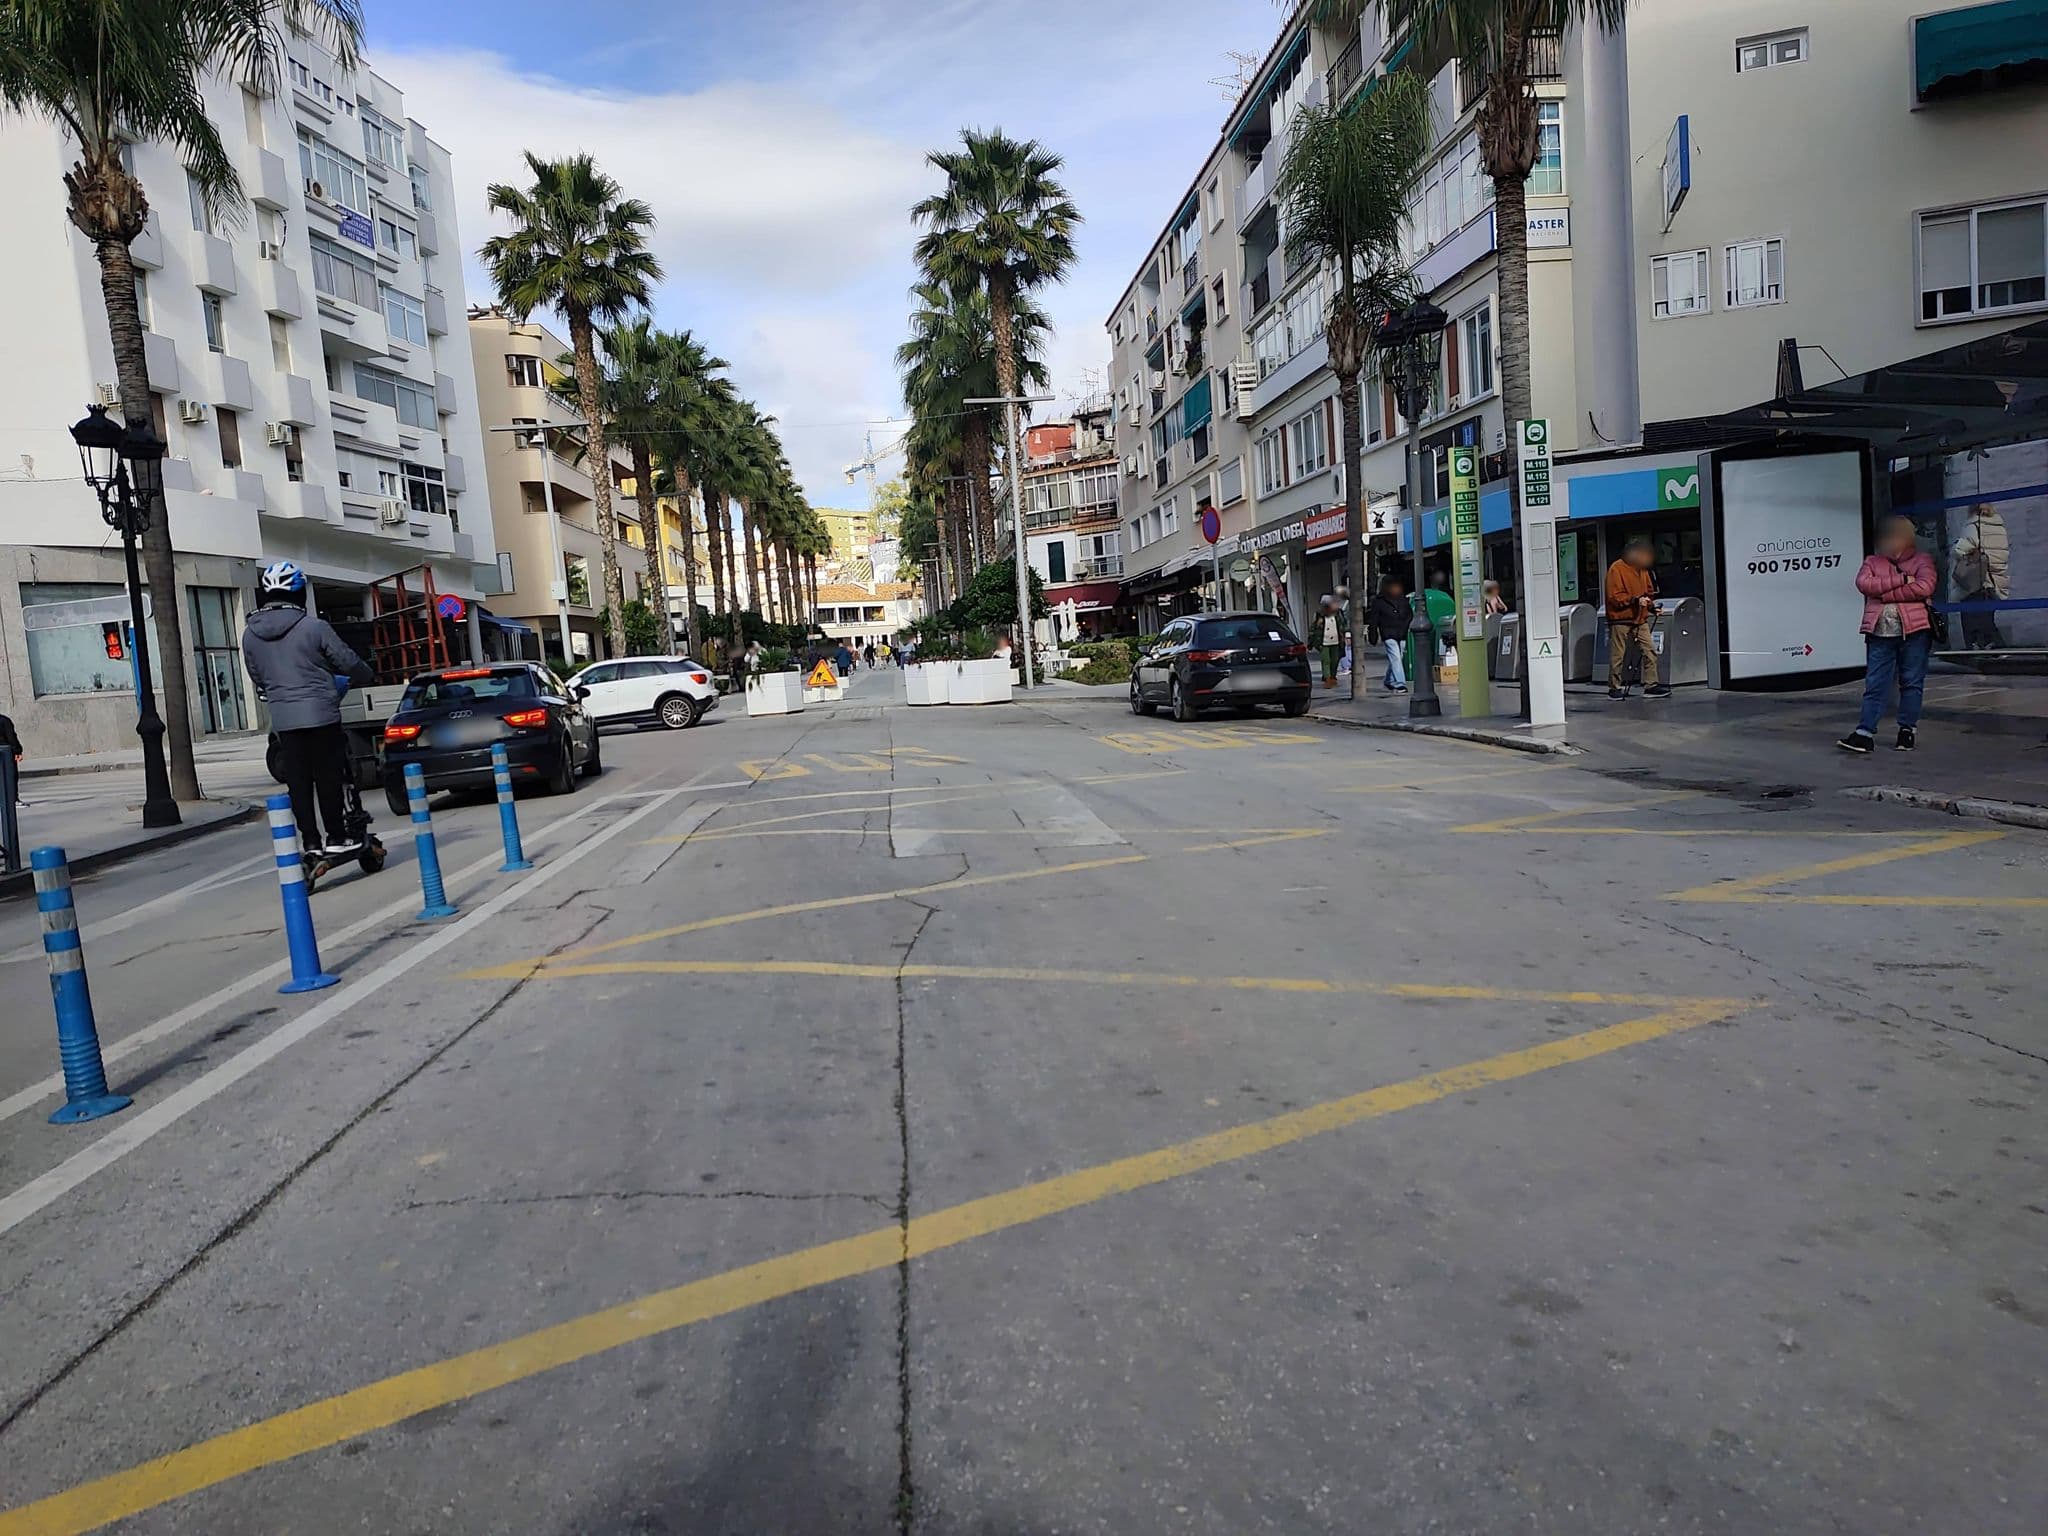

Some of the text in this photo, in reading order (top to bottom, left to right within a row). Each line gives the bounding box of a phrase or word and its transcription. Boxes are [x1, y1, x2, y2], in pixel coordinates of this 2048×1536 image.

[1538, 445, 1547, 456] B
[1526, 461, 1547, 469] M.110
[1526, 472, 1548, 480] M.112
[1468, 479, 1477, 488] B
[1527, 485, 1548, 493] M.120
[1528, 496, 1549, 505] M.121
[1282, 521, 1306, 541] OMEGA
[1306, 512, 1347, 541] SUPERMARKET
[1757, 537, 1831, 553] anúnciate
[1747, 554, 1841, 574] 900 750 757
[1098, 726, 1328, 753] BUS
